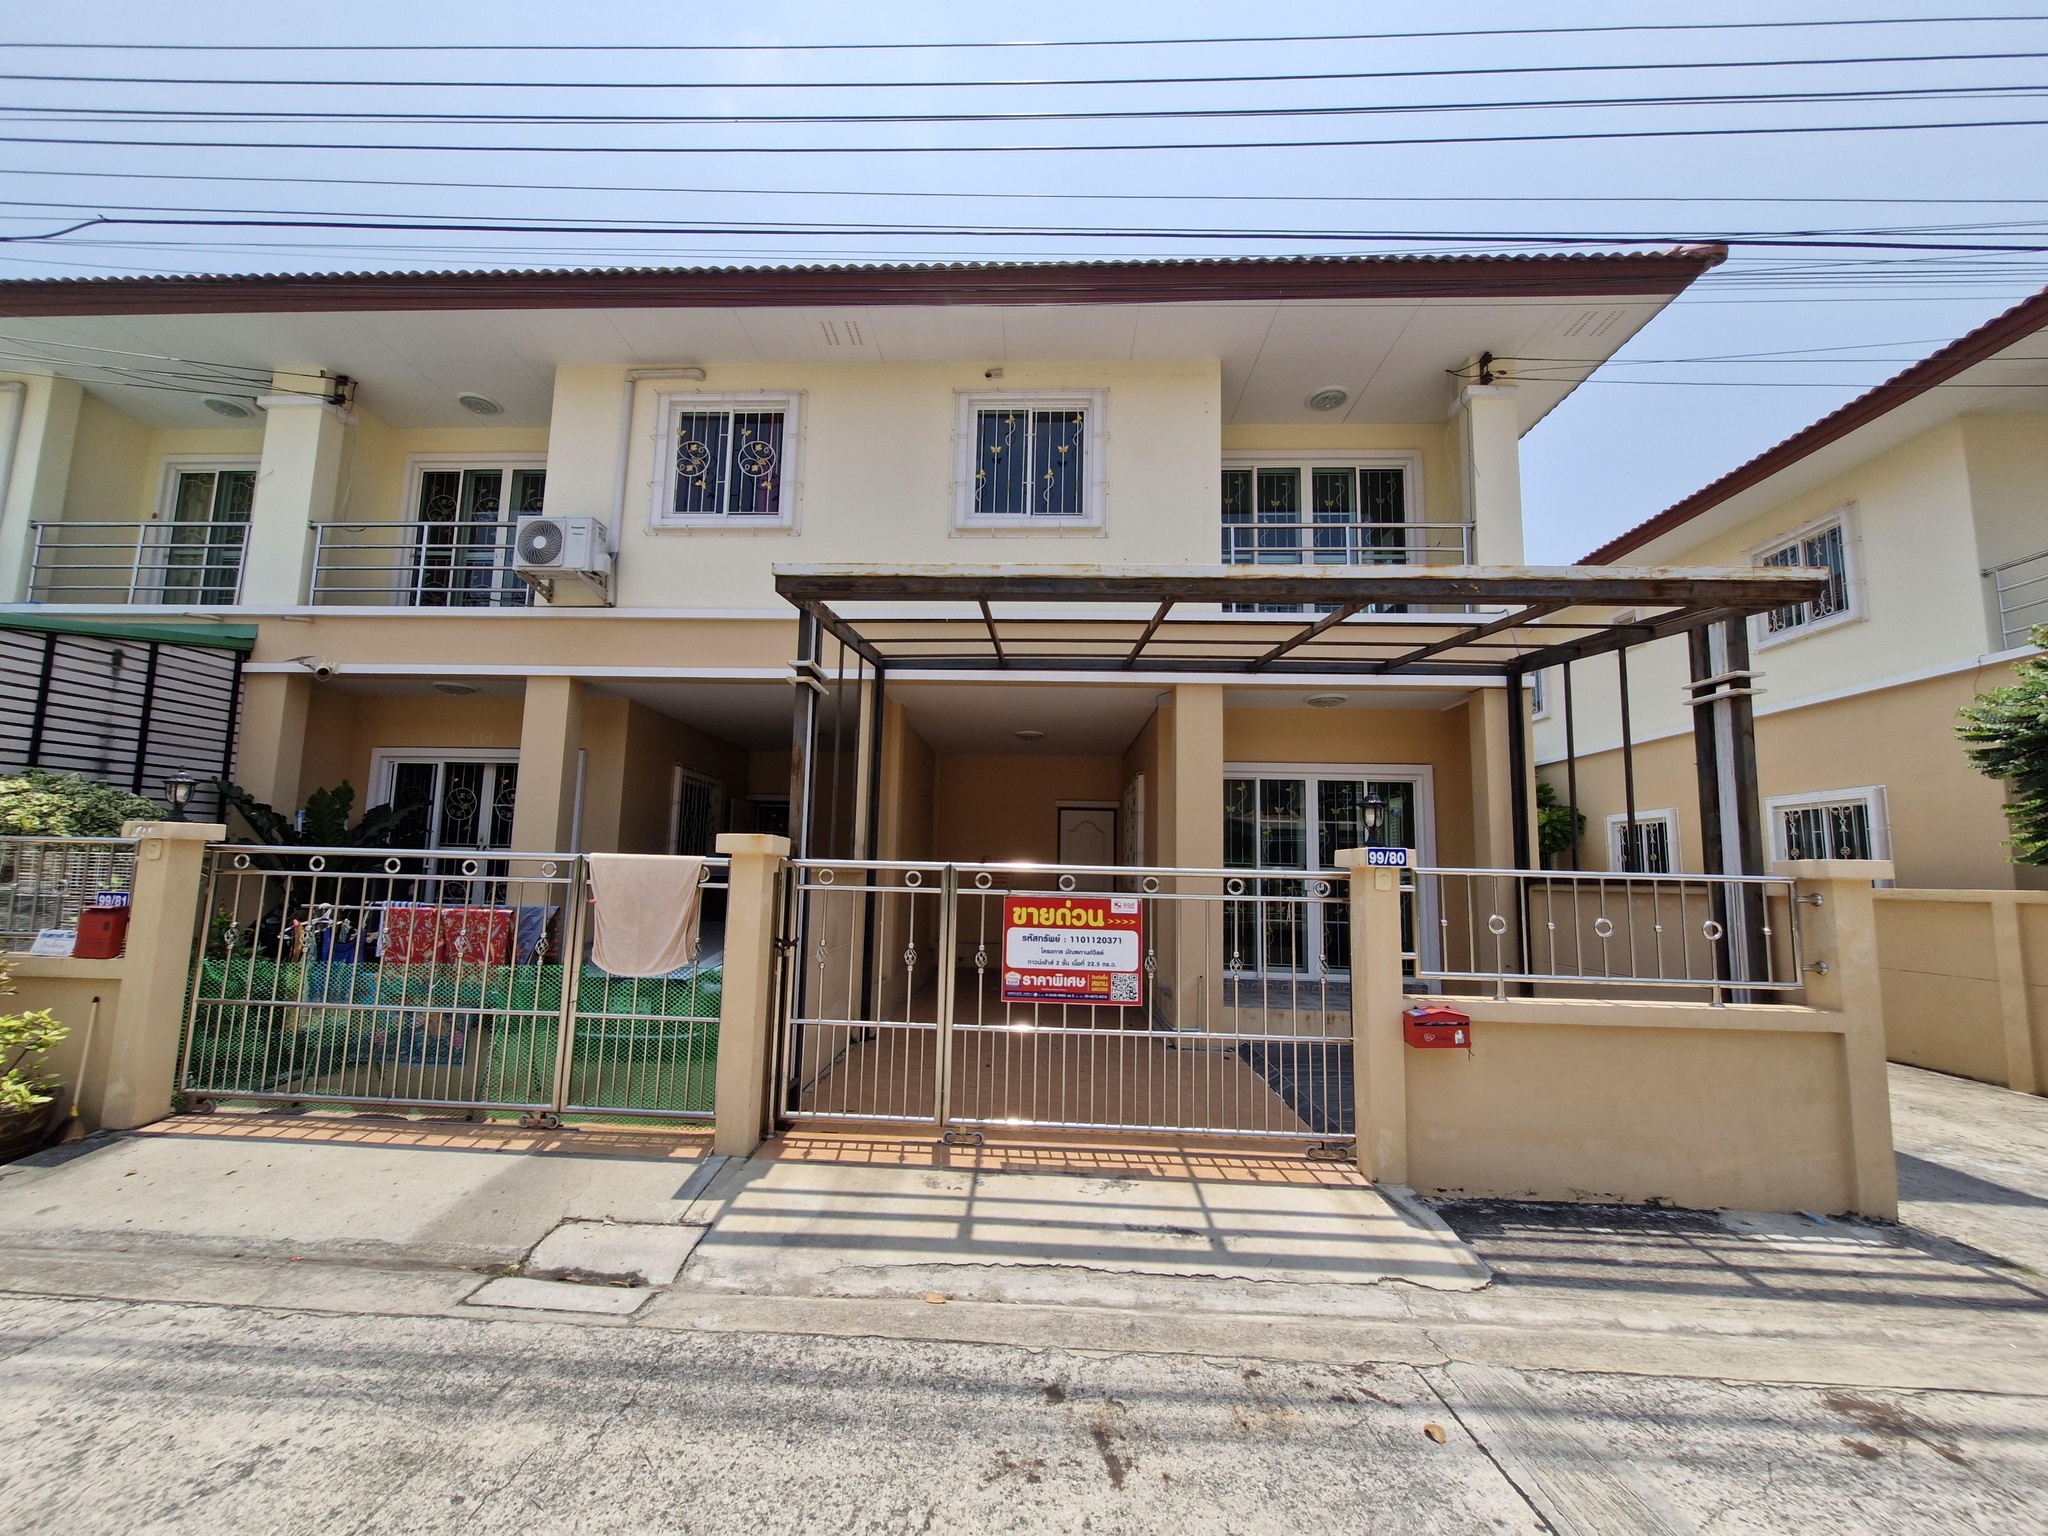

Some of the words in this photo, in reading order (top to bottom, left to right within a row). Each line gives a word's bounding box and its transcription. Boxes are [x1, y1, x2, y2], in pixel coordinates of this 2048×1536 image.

[1369, 851, 1405, 865] 99/80
[98, 894, 127, 907] 99/81
[1013, 900, 1105, 927] ขายด่วน
[1022, 933, 1061, 943] รหัสทรัพย์
[1070, 936, 1122, 945] 1101120371
[1022, 973, 1086, 987] ราคาพิเศษ
